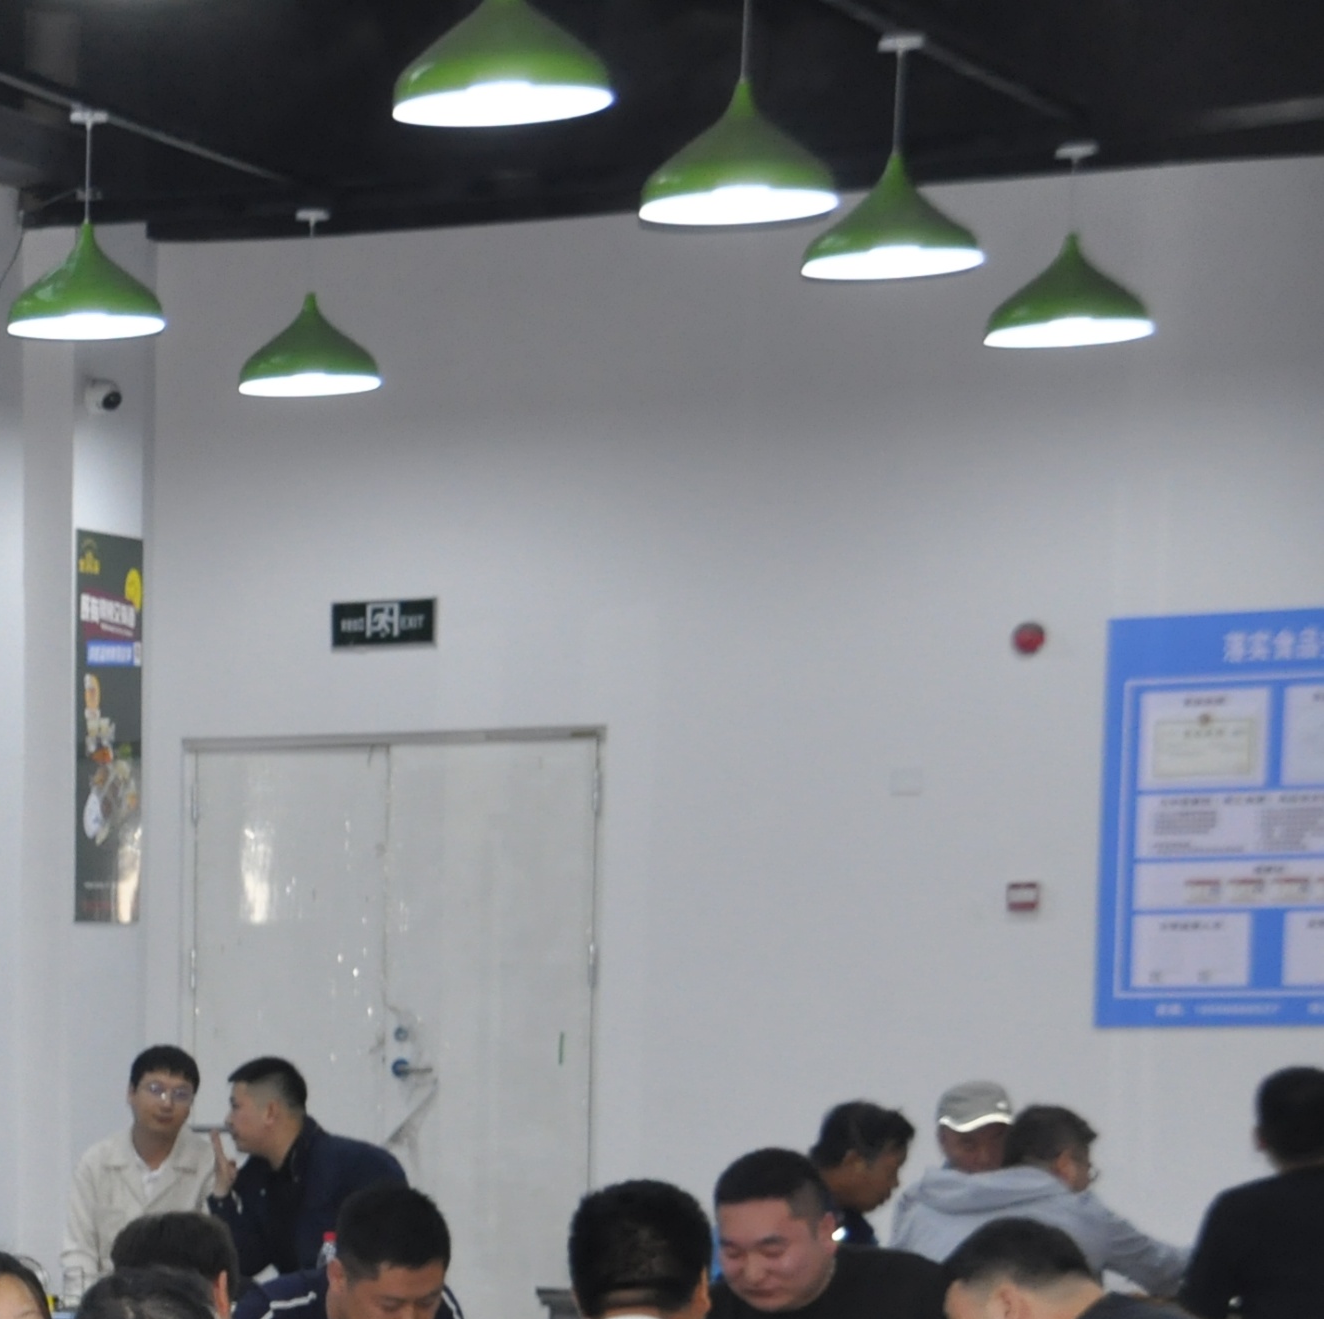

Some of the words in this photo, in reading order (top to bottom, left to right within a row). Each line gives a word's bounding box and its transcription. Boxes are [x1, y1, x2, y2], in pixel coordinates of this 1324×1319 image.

[400, 613, 425, 630] EXIT
[1223, 626, 1324, 663] 落实食品
